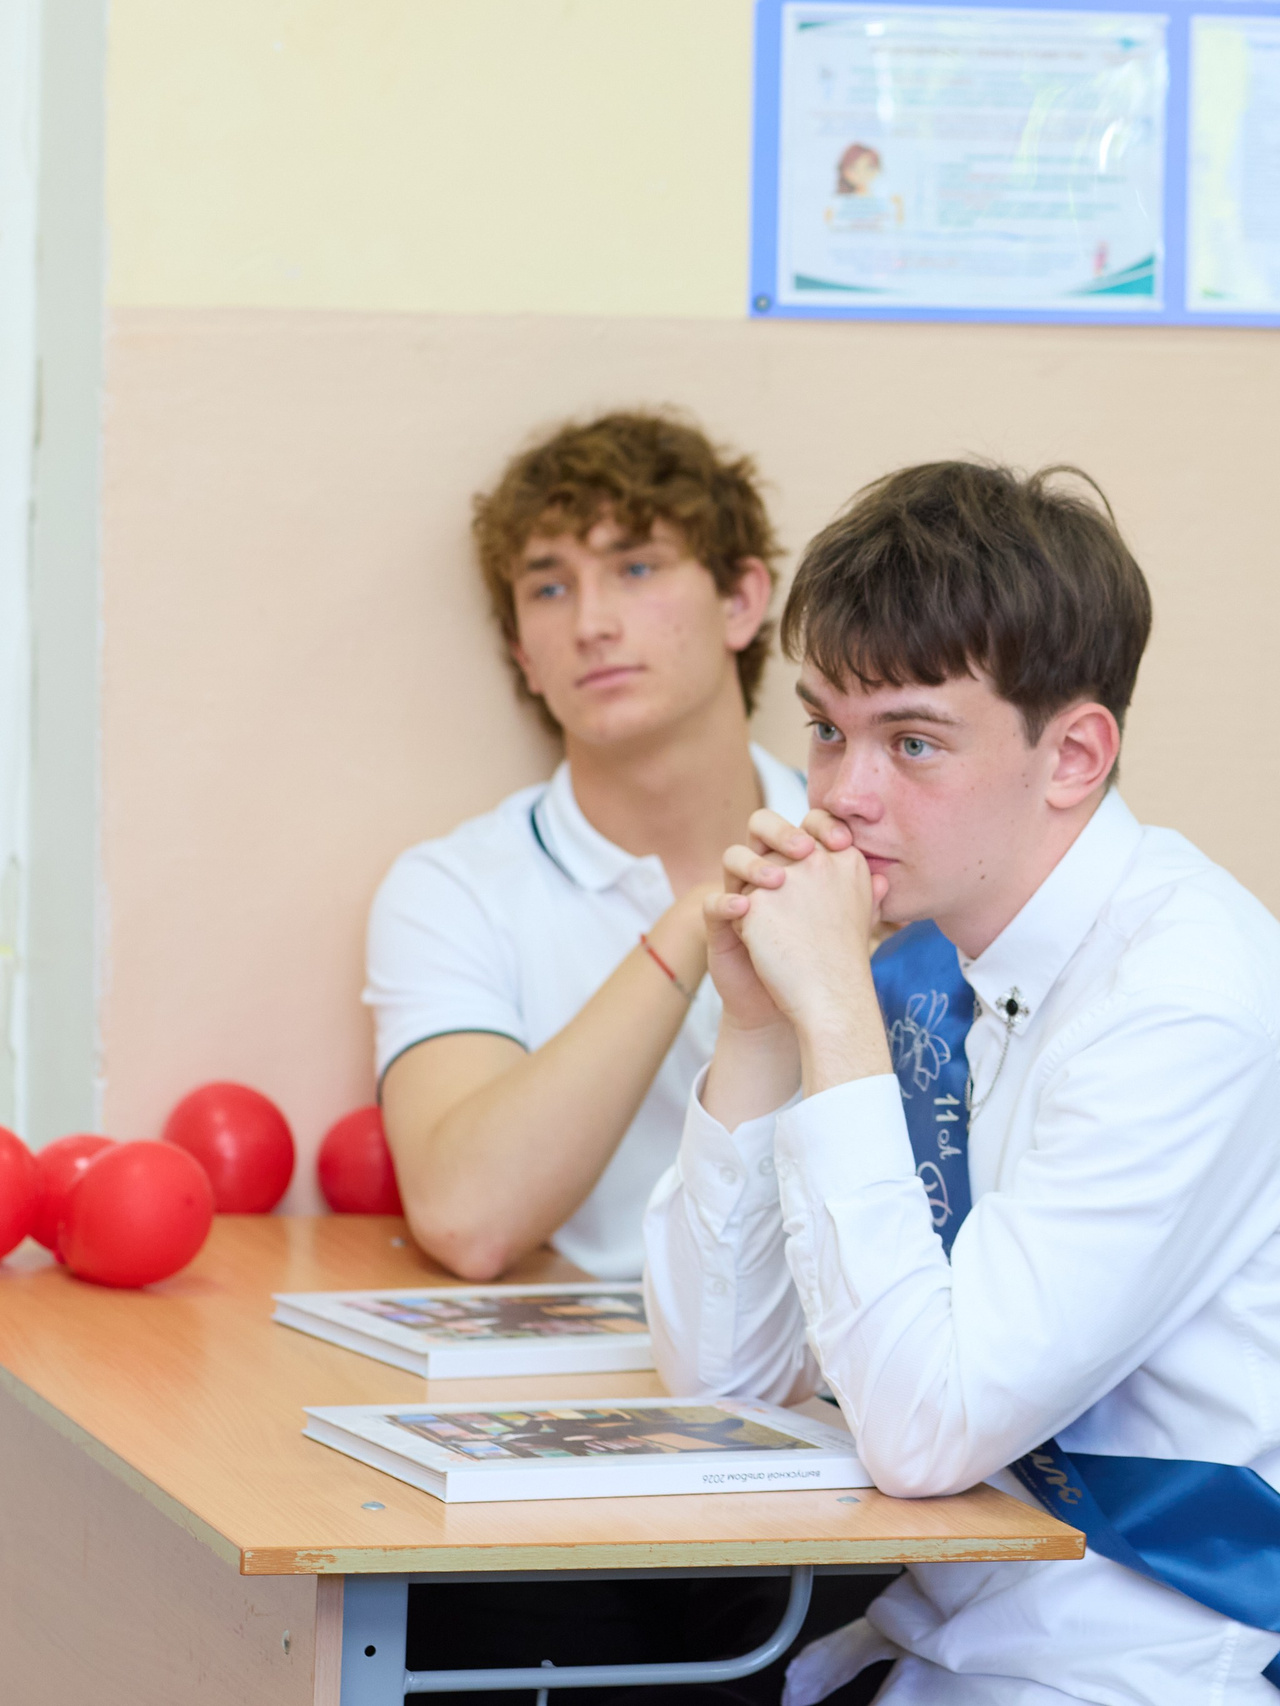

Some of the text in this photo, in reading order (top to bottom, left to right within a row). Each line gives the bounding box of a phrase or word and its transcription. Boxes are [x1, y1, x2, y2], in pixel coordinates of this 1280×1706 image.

[934, 1093, 961, 1122] 11
[701, 1469, 821, 1484] выпускной альбом 2026
